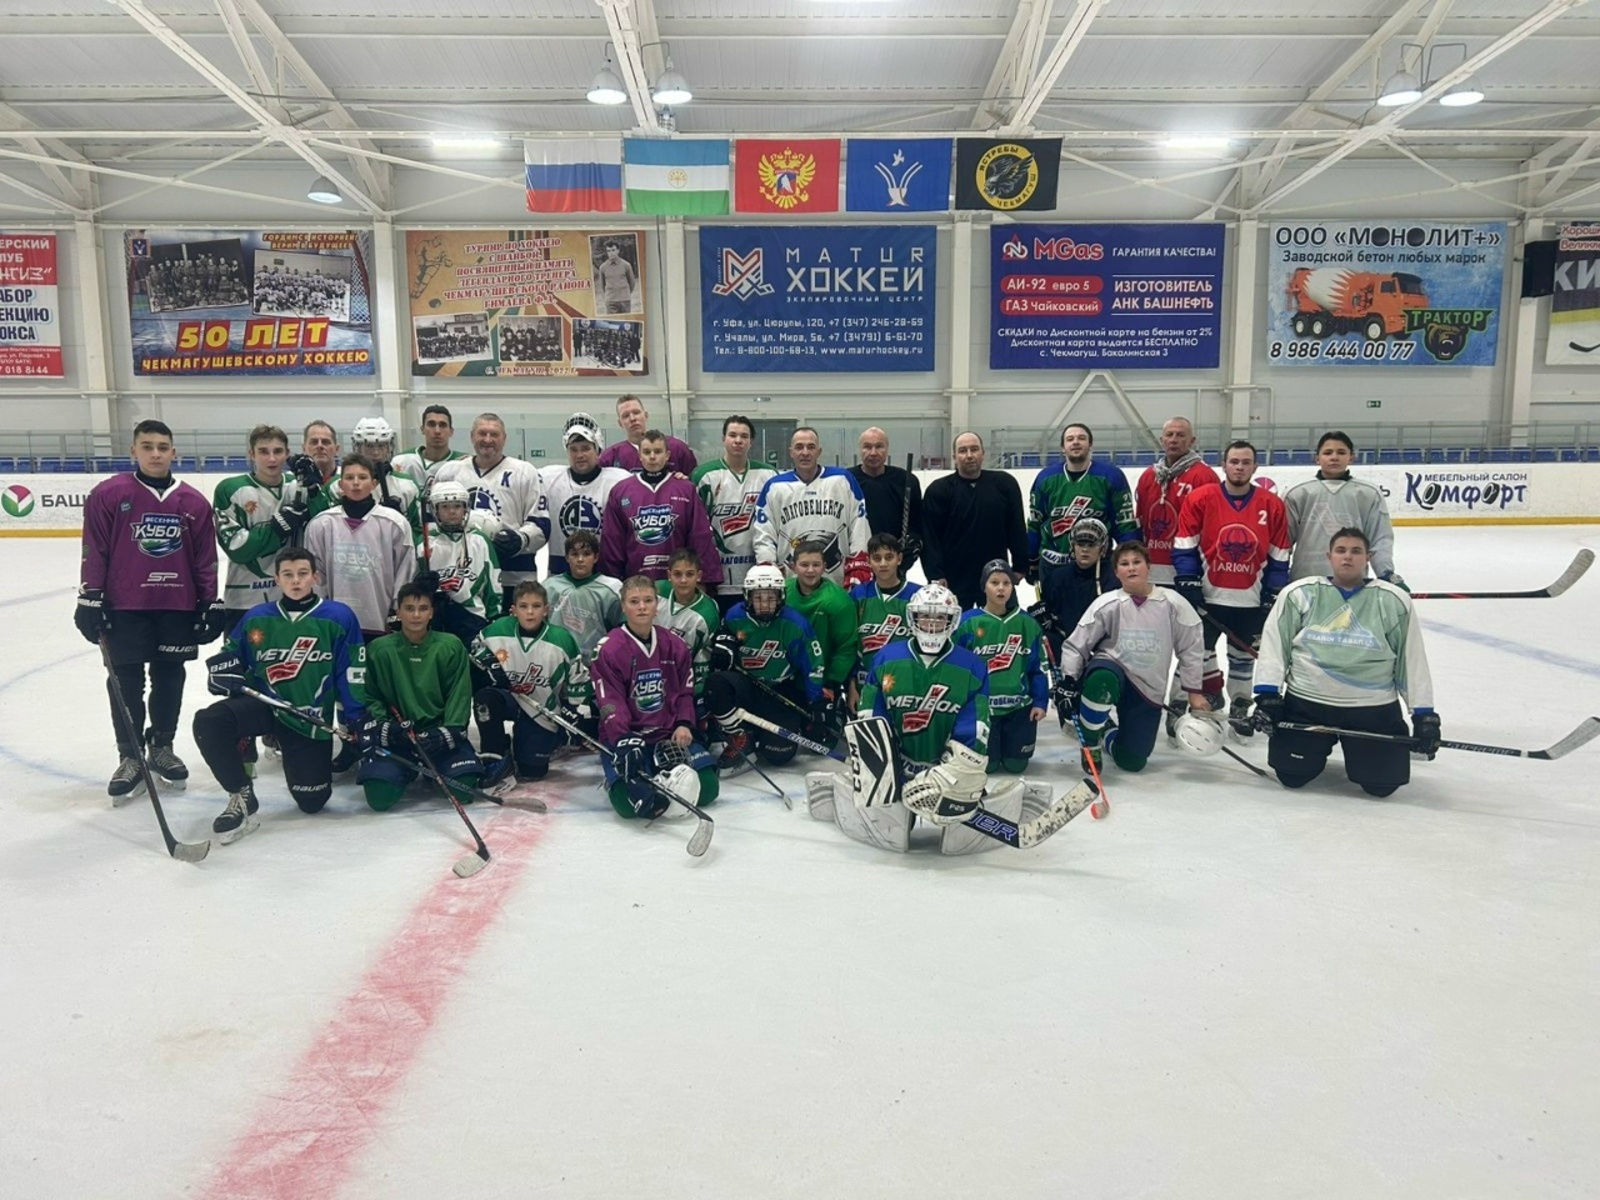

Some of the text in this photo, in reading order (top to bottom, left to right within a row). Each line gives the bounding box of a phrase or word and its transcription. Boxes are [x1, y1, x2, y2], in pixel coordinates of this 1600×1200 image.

[1275, 226, 1327, 246] ООО
[786, 247, 924, 263] MATUR
[1033, 237, 1104, 261] MGas
[1112, 246, 1217, 257] ГАРАНТИЯ КАЧЕСТВА!
[1282, 250, 1487, 265] Заводской бетон любых марок
[786, 267, 924, 292] ХОККЕЙ
[1006, 279, 1090, 293] АИ-92 евро 5
[1114, 280, 1213, 293] ИЗГОТОВИТЕЛЬ
[1005, 299, 1099, 312] ГАЗ Чайковский
[1112, 297, 1214, 310] АНК БАШНЕФТЬ
[807, 318, 826, 328] 120,
[828, 318, 839, 327] +7
[842, 317, 869, 328] (347)
[1411, 310, 1485, 327] ТРАКТОР
[179, 323, 327, 348] 50 ЛЕТ
[828, 333, 840, 341] +7
[997, 328, 1035, 337] СКИДКИ
[1050, 328, 1106, 337] Дисконтной
[1108, 329, 1136, 337] карте
[1151, 327, 1185, 336] бензин
[1199, 327, 1213, 336] 2%
[1010, 337, 1199, 348] Дисконтная карта выдается БЕСПЛАТНО
[820, 346, 924, 355] www.maturhockey.ru
[1162, 348, 1169, 357] 3
[1270, 342, 1416, 359] 8 986 444 00 77
[141, 352, 369, 370] ЧЕКМАГУШЕВСКОМУ ХОККЕЮ
[1424, 472, 1527, 482] МЕБЕЛЬНЫЙ САЛОН
[1405, 472, 1527, 510] Комфорт
[42, 494, 91, 508] БАШ
[1258, 510, 1267, 525] 2
[1217, 561, 1251, 572] ARION
[811, 640, 822, 656] 8
[960, 751, 982, 765] CCM
[849, 742, 862, 793] CCM
